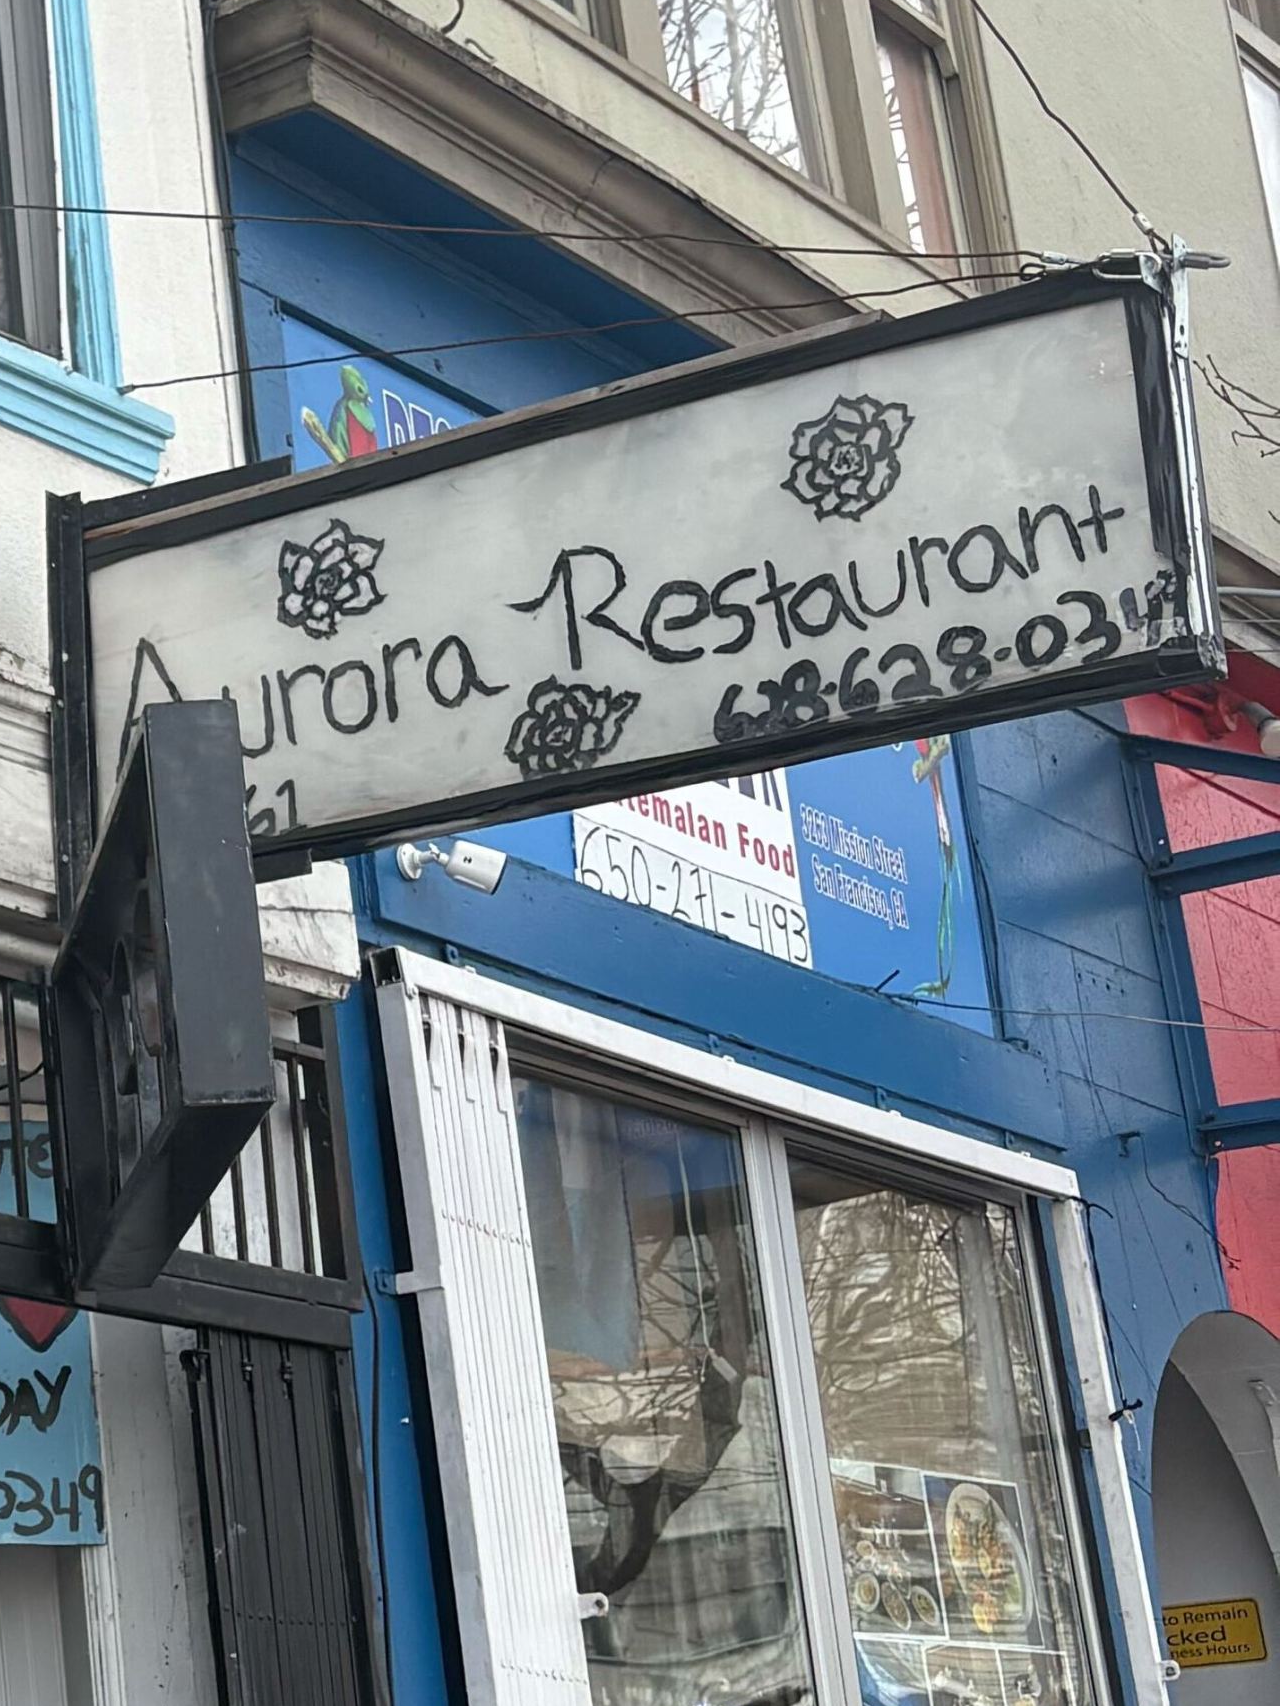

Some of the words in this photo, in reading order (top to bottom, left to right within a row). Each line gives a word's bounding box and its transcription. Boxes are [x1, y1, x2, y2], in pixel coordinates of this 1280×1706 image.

[116, 638, 508, 783] Aurora
[507, 484, 1126, 669] Restaurant
[737, 822, 796, 878] Food
[829, 815, 874, 870] Mission
[872, 835, 908, 885] Street
[812, 853, 836, 900] San
[890, 888, 910, 930] CA
[1184, 1607, 1248, 1624] Remain
[1206, 1643, 1250, 1655] Hours
